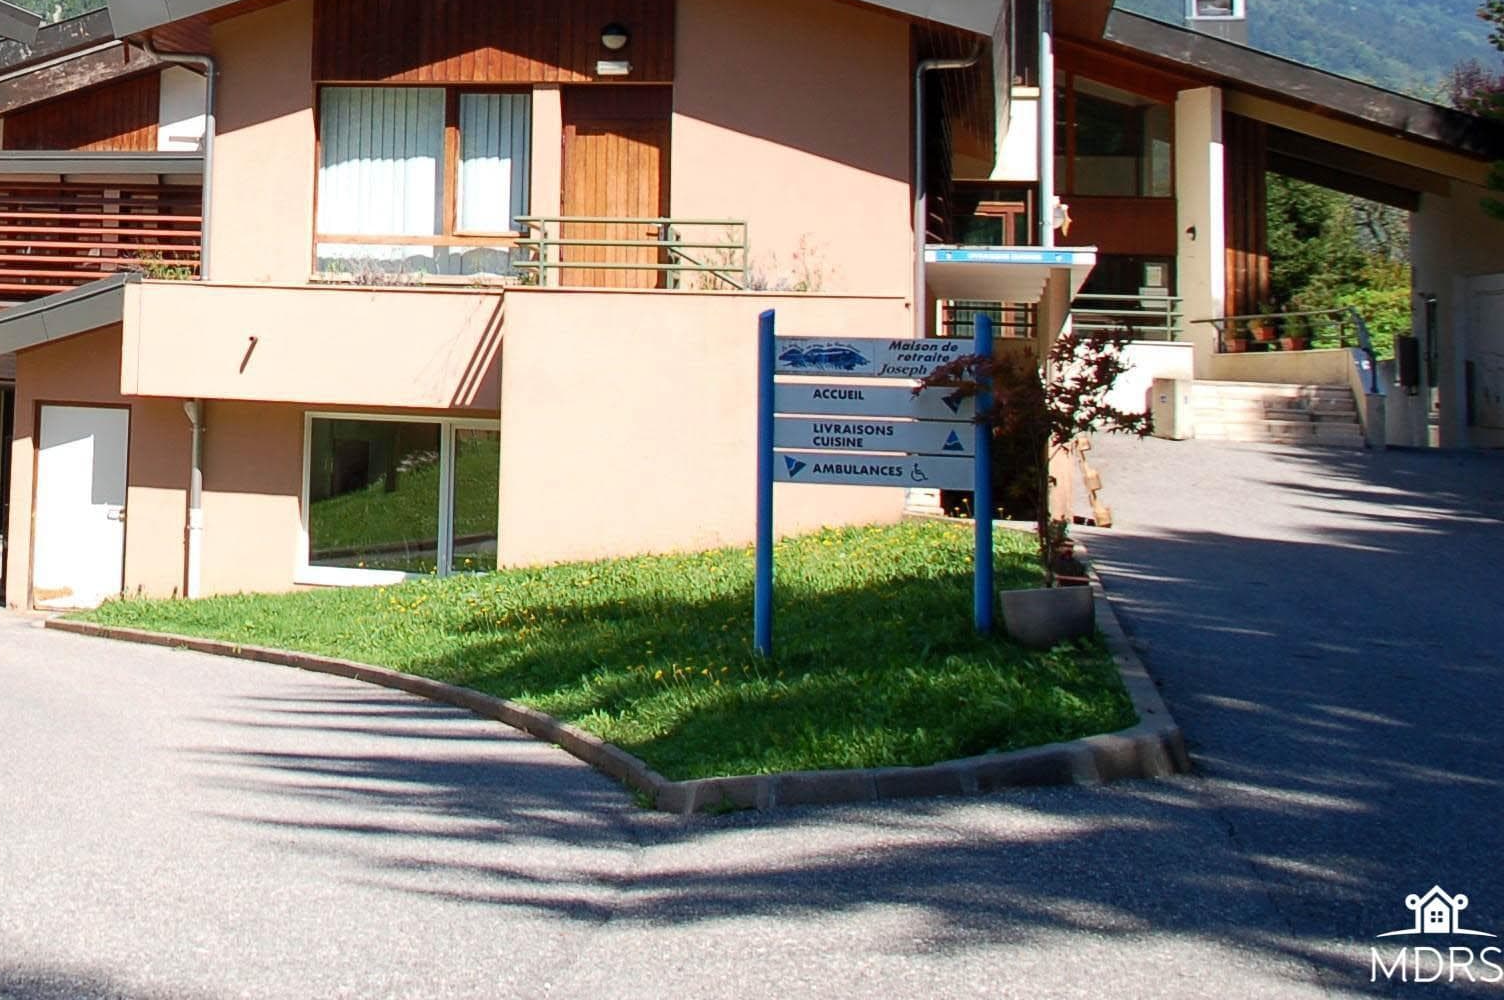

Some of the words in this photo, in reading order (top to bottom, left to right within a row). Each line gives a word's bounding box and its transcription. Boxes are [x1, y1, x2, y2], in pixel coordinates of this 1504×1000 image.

[889, 341, 938, 352] Maison
[942, 341, 959, 352] de
[897, 353, 951, 362] retraite
[878, 364, 928, 376] Joseph
[813, 389, 865, 400] ACCUEIL
[813, 424, 894, 436] LIVRAISONS
[813, 436, 863, 448] CUISINE
[813, 464, 903, 477] AMBULANCES
